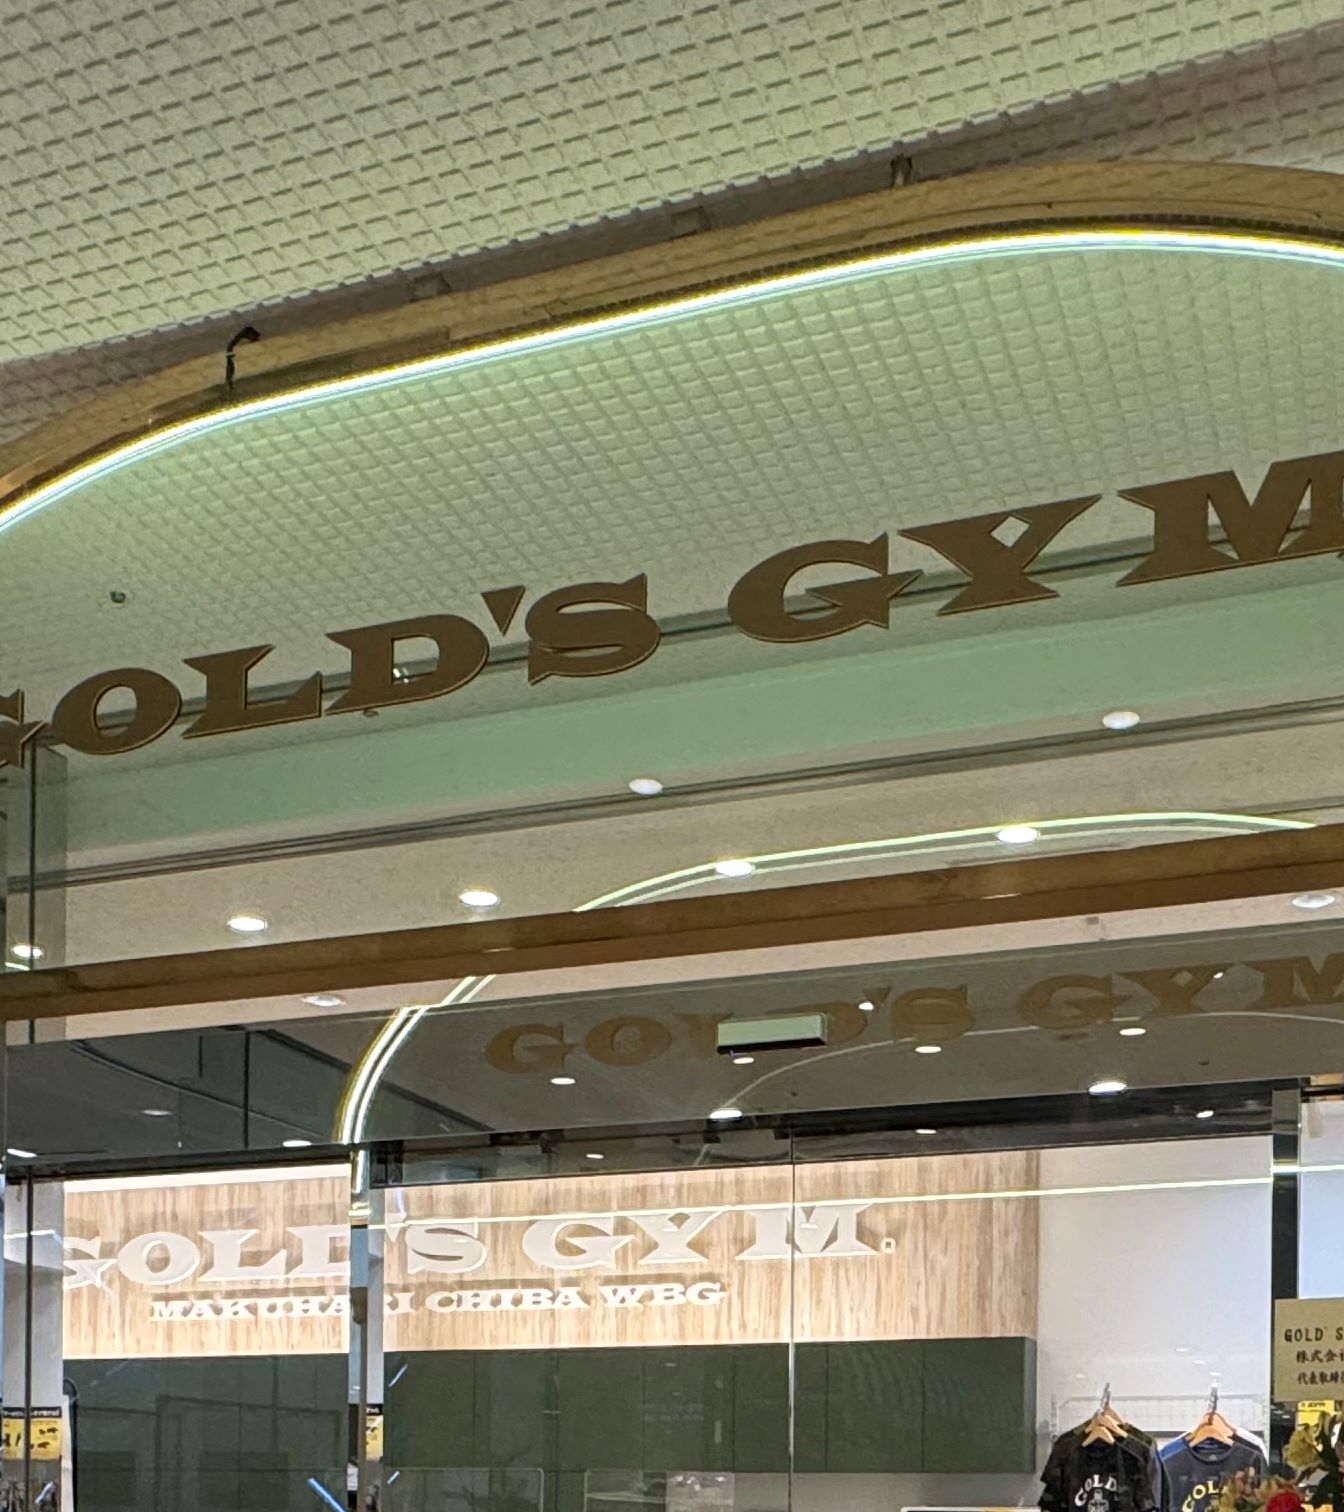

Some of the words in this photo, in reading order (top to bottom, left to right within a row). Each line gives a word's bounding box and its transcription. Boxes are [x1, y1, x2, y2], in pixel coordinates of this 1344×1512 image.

[522, 1202, 879, 1271] GYM
[150, 1291, 416, 1322] MAKUHAI
[427, 1287, 590, 1313] CHIBA
[600, 1281, 728, 1309] WBG
